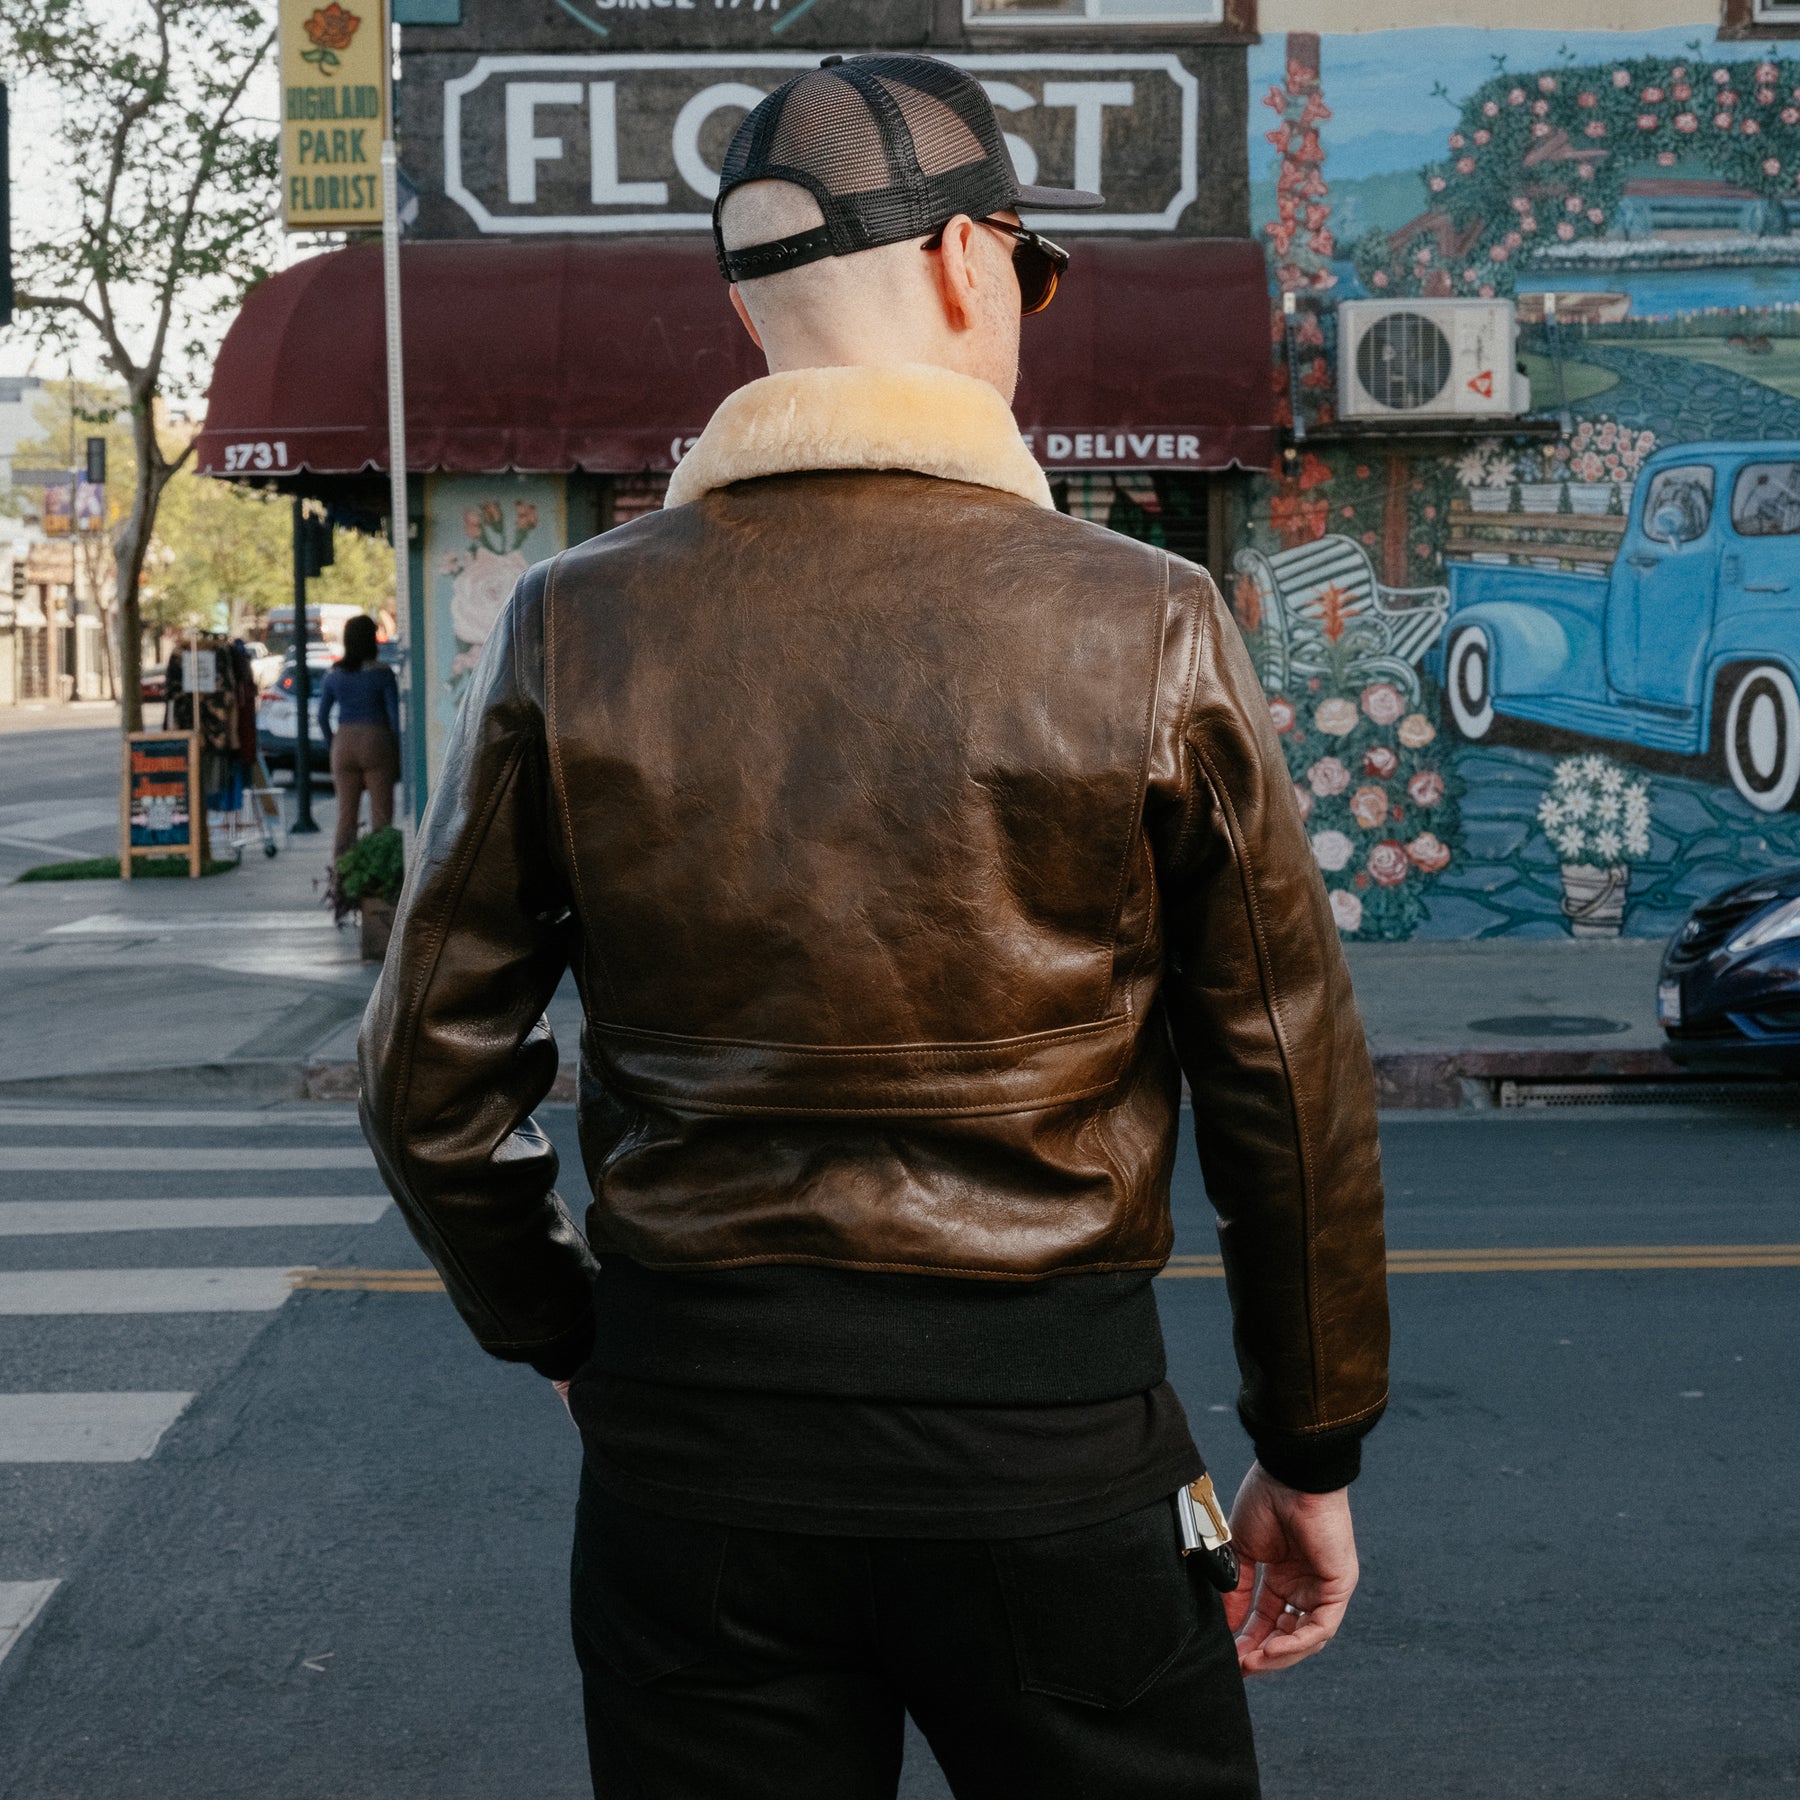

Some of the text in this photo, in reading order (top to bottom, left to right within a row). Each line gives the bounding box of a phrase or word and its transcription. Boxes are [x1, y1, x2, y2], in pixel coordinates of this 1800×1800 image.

[287, 85, 378, 120] HIGHLAND
[298, 129, 367, 164] PARK
[290, 174, 376, 210] FLORIST
[224, 441, 288, 472] 5731
[1047, 434, 1200, 459] DELIVER
